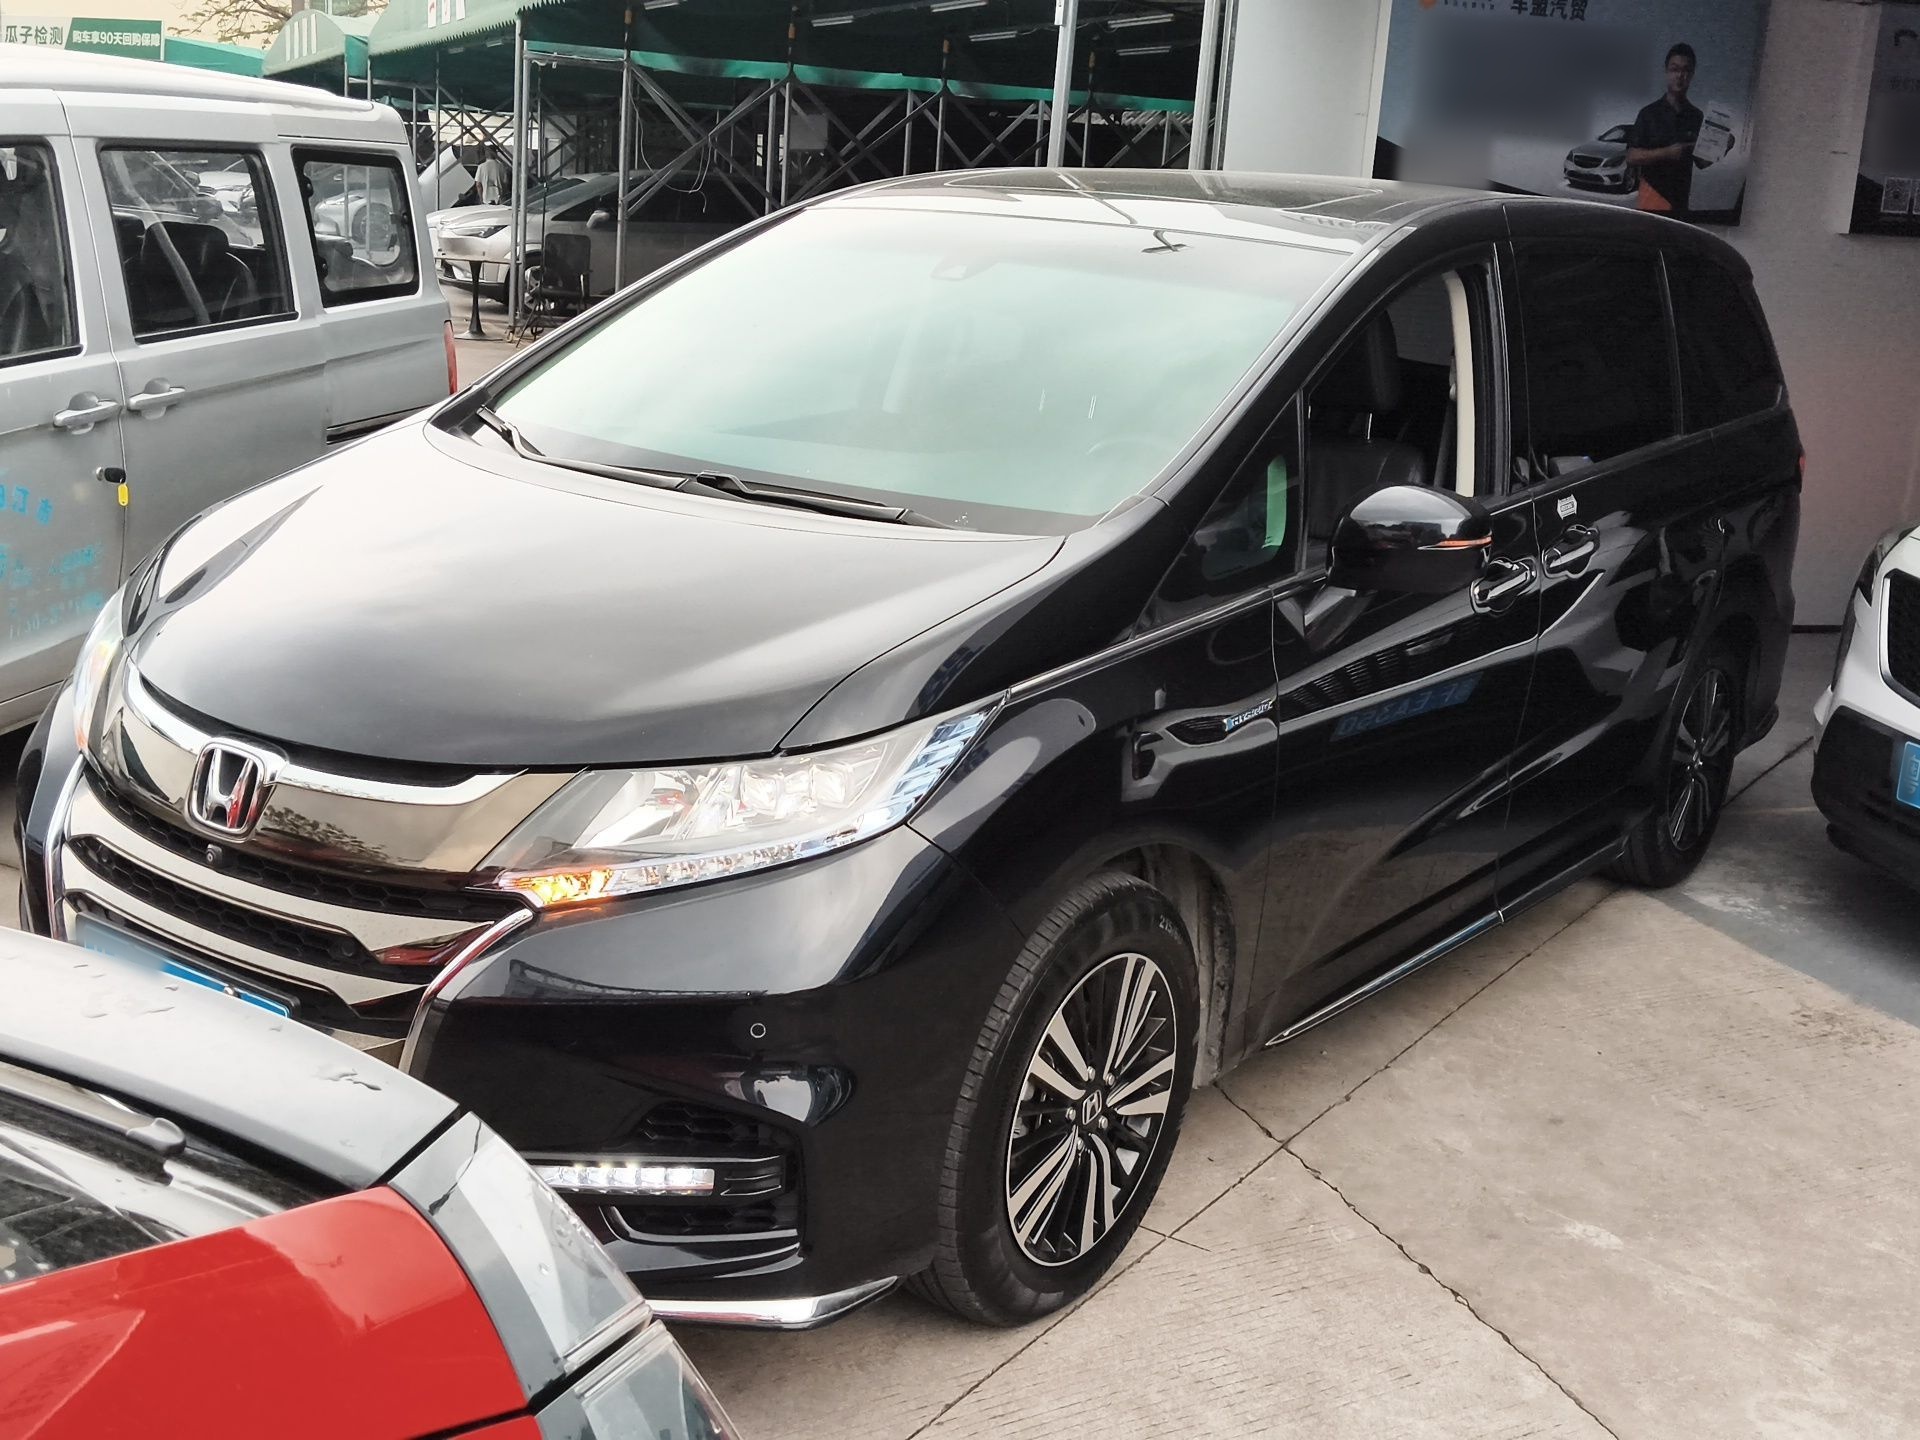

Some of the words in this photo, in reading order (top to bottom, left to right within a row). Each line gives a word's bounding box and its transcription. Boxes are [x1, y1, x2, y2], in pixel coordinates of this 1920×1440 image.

[5, 25, 63, 45] 瓜子检测
[72, 30, 161, 47] 购车享90天回购保障
